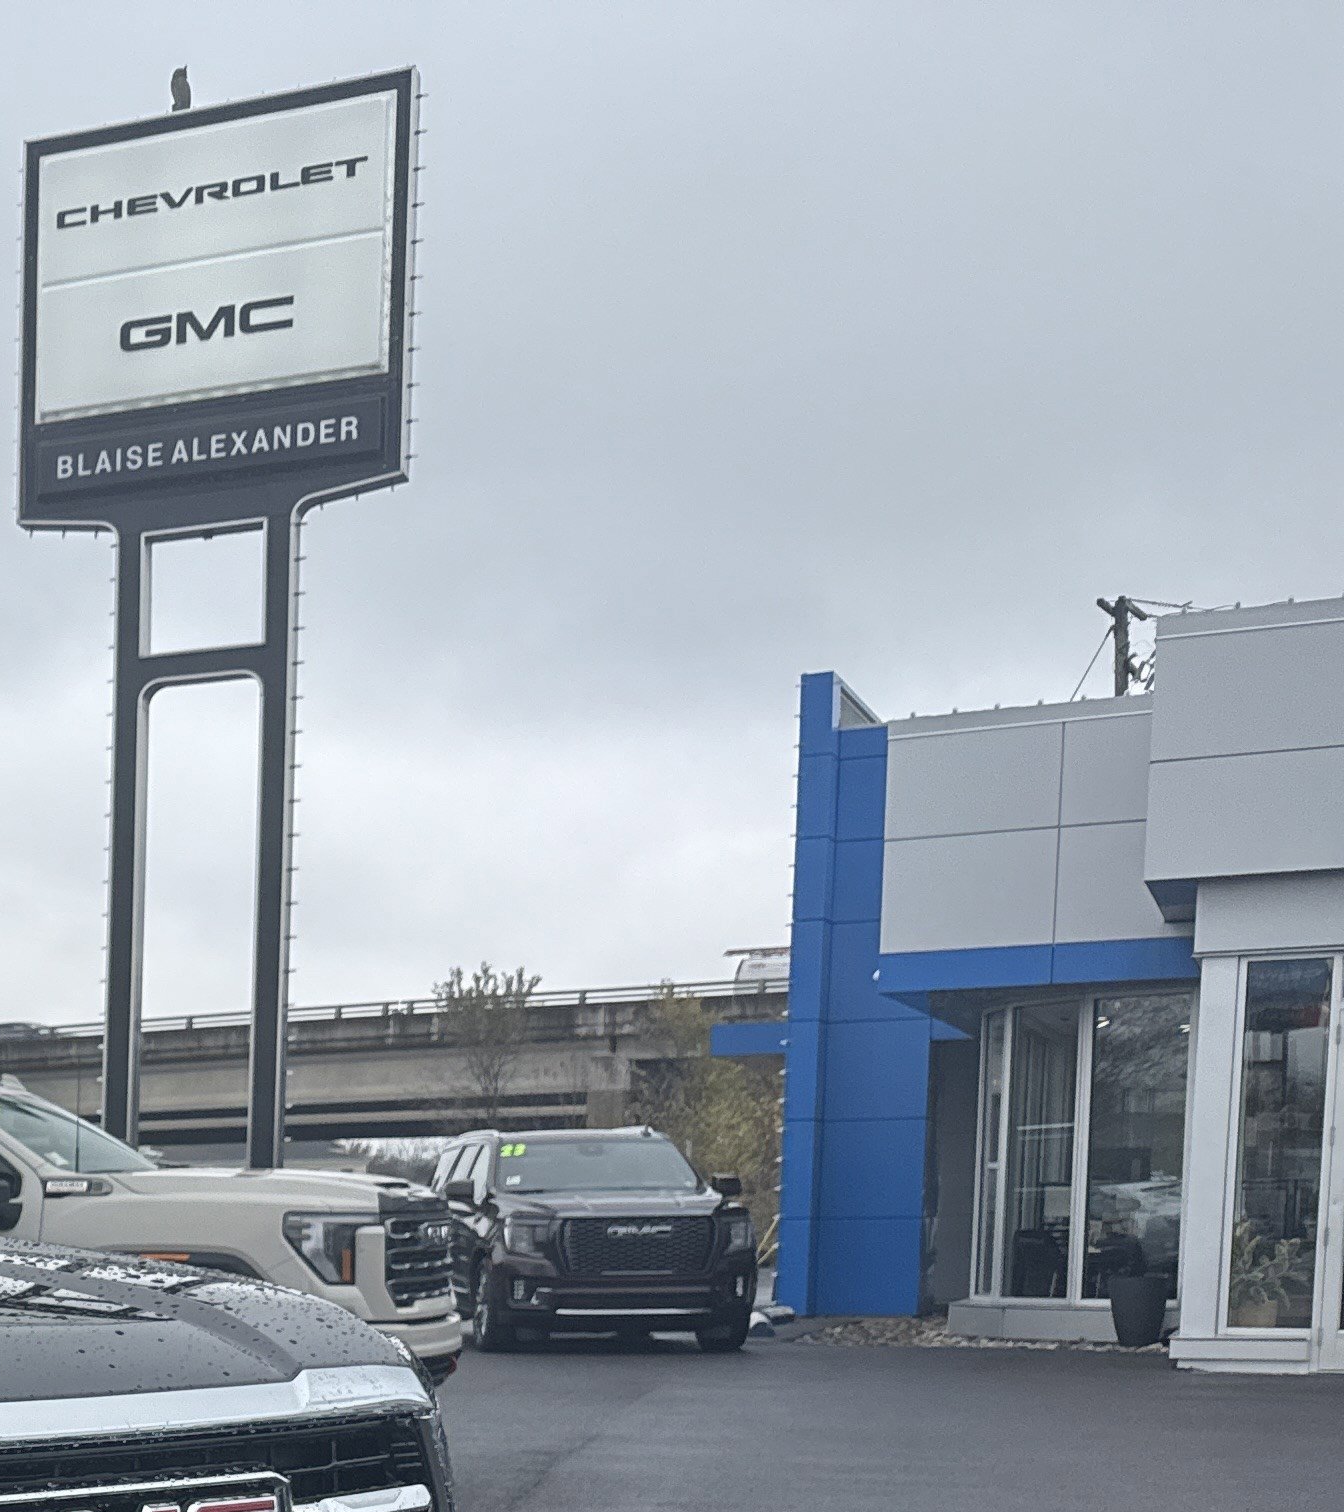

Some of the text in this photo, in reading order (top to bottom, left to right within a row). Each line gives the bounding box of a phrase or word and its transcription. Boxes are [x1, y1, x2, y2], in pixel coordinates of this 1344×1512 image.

[56, 156, 369, 230] CHEVROLET
[119, 295, 295, 353] GMC
[56, 415, 360, 480] BLAISE ALEXANDER
